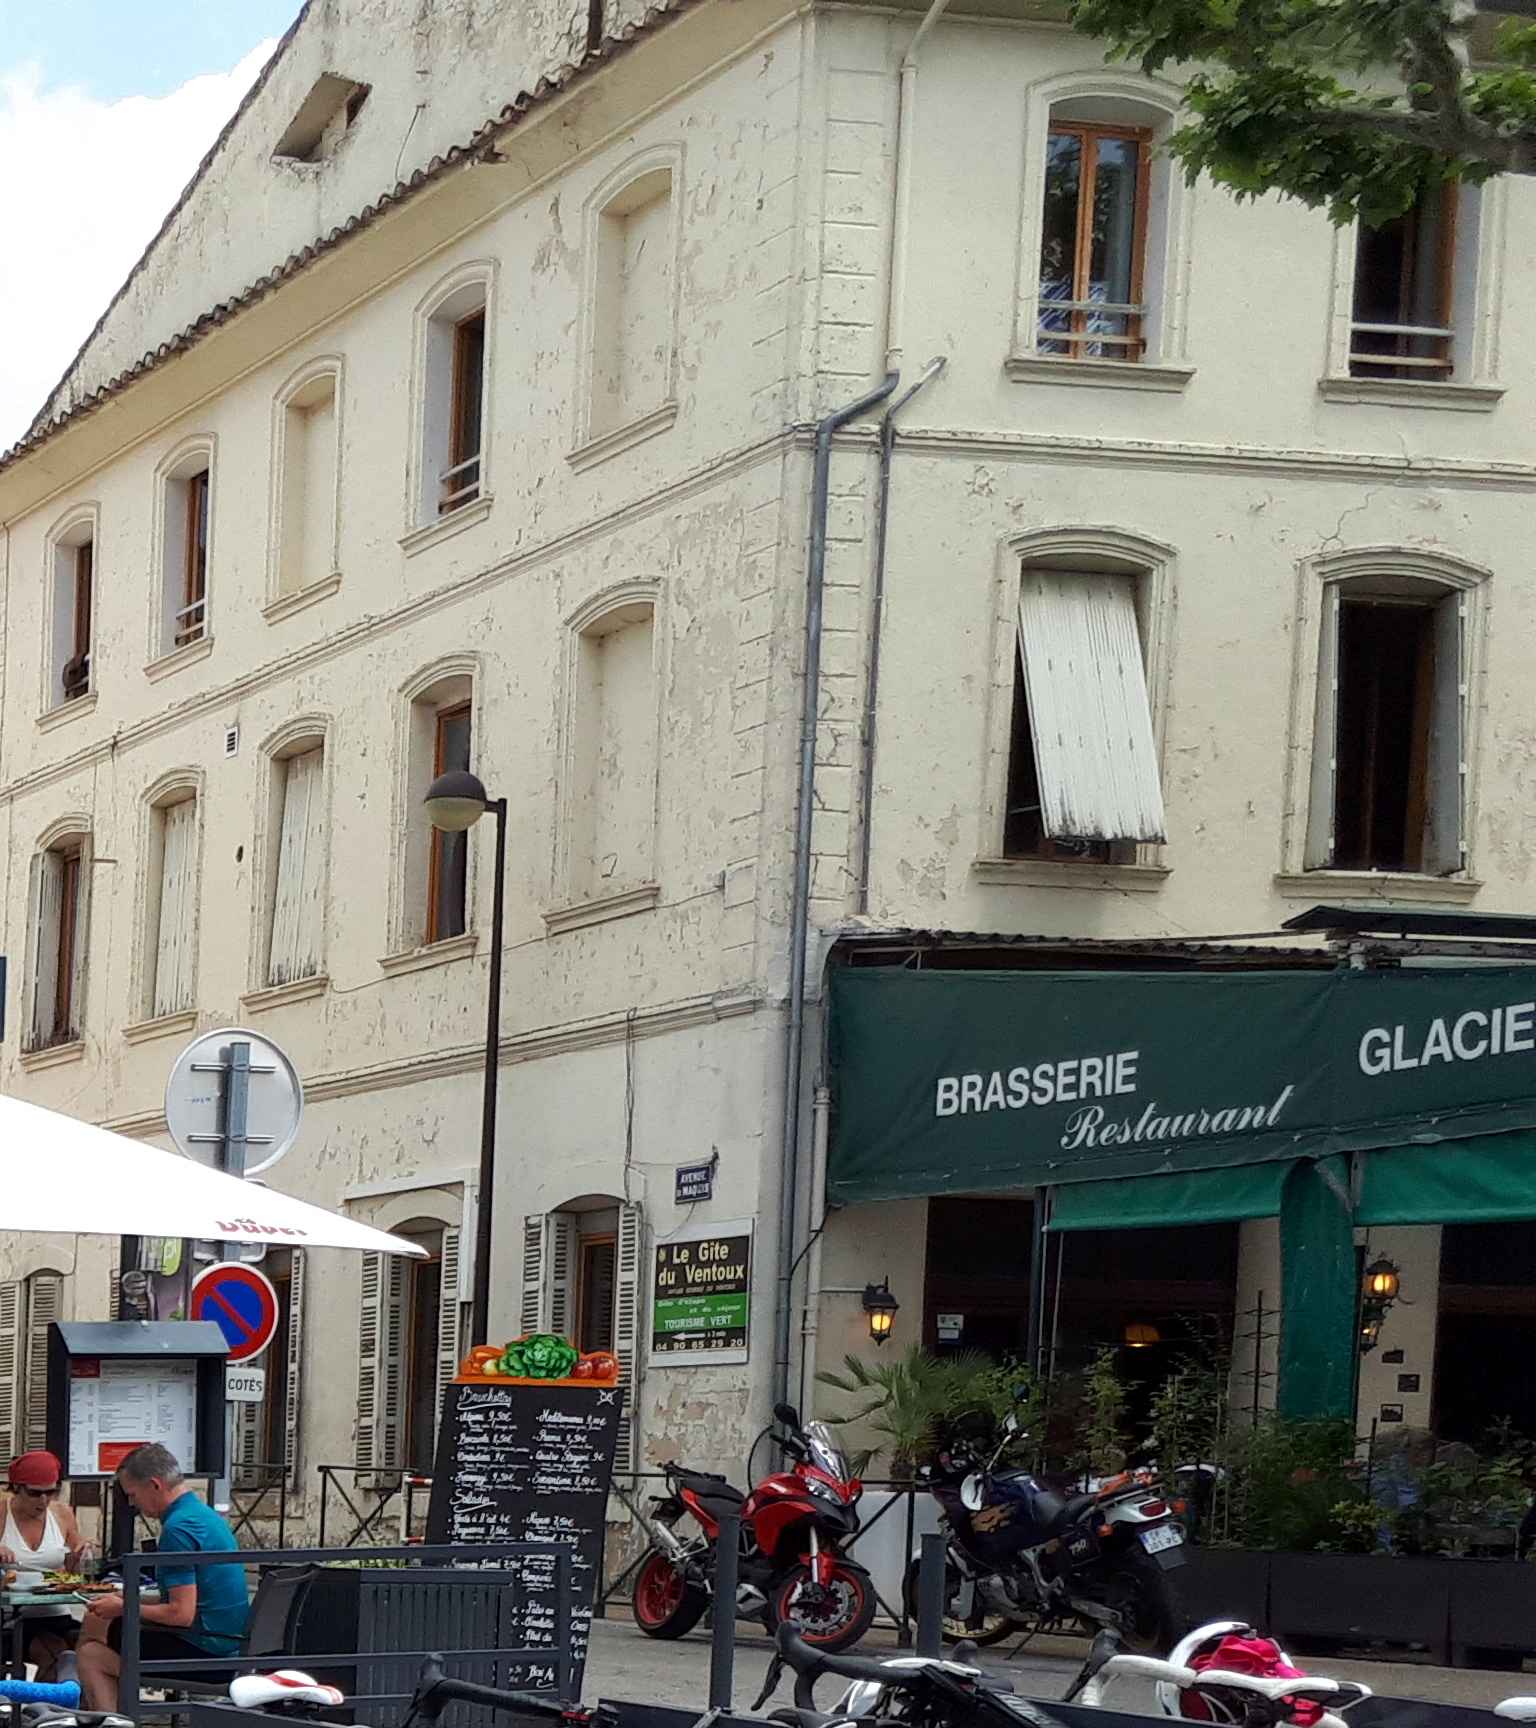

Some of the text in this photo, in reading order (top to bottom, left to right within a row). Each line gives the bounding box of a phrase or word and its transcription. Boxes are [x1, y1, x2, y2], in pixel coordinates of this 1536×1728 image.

[935, 1050, 1139, 1117] BRASSERIE
[1060, 1085, 1296, 1151] Restaurant
[672, 1245, 690, 1265] Le
[658, 1264, 745, 1286] du Ventoux
[664, 1315, 733, 1330] TOURISME VERT
[656, 1343, 668, 1353] 04
[730, 1338, 744, 1348] 20
